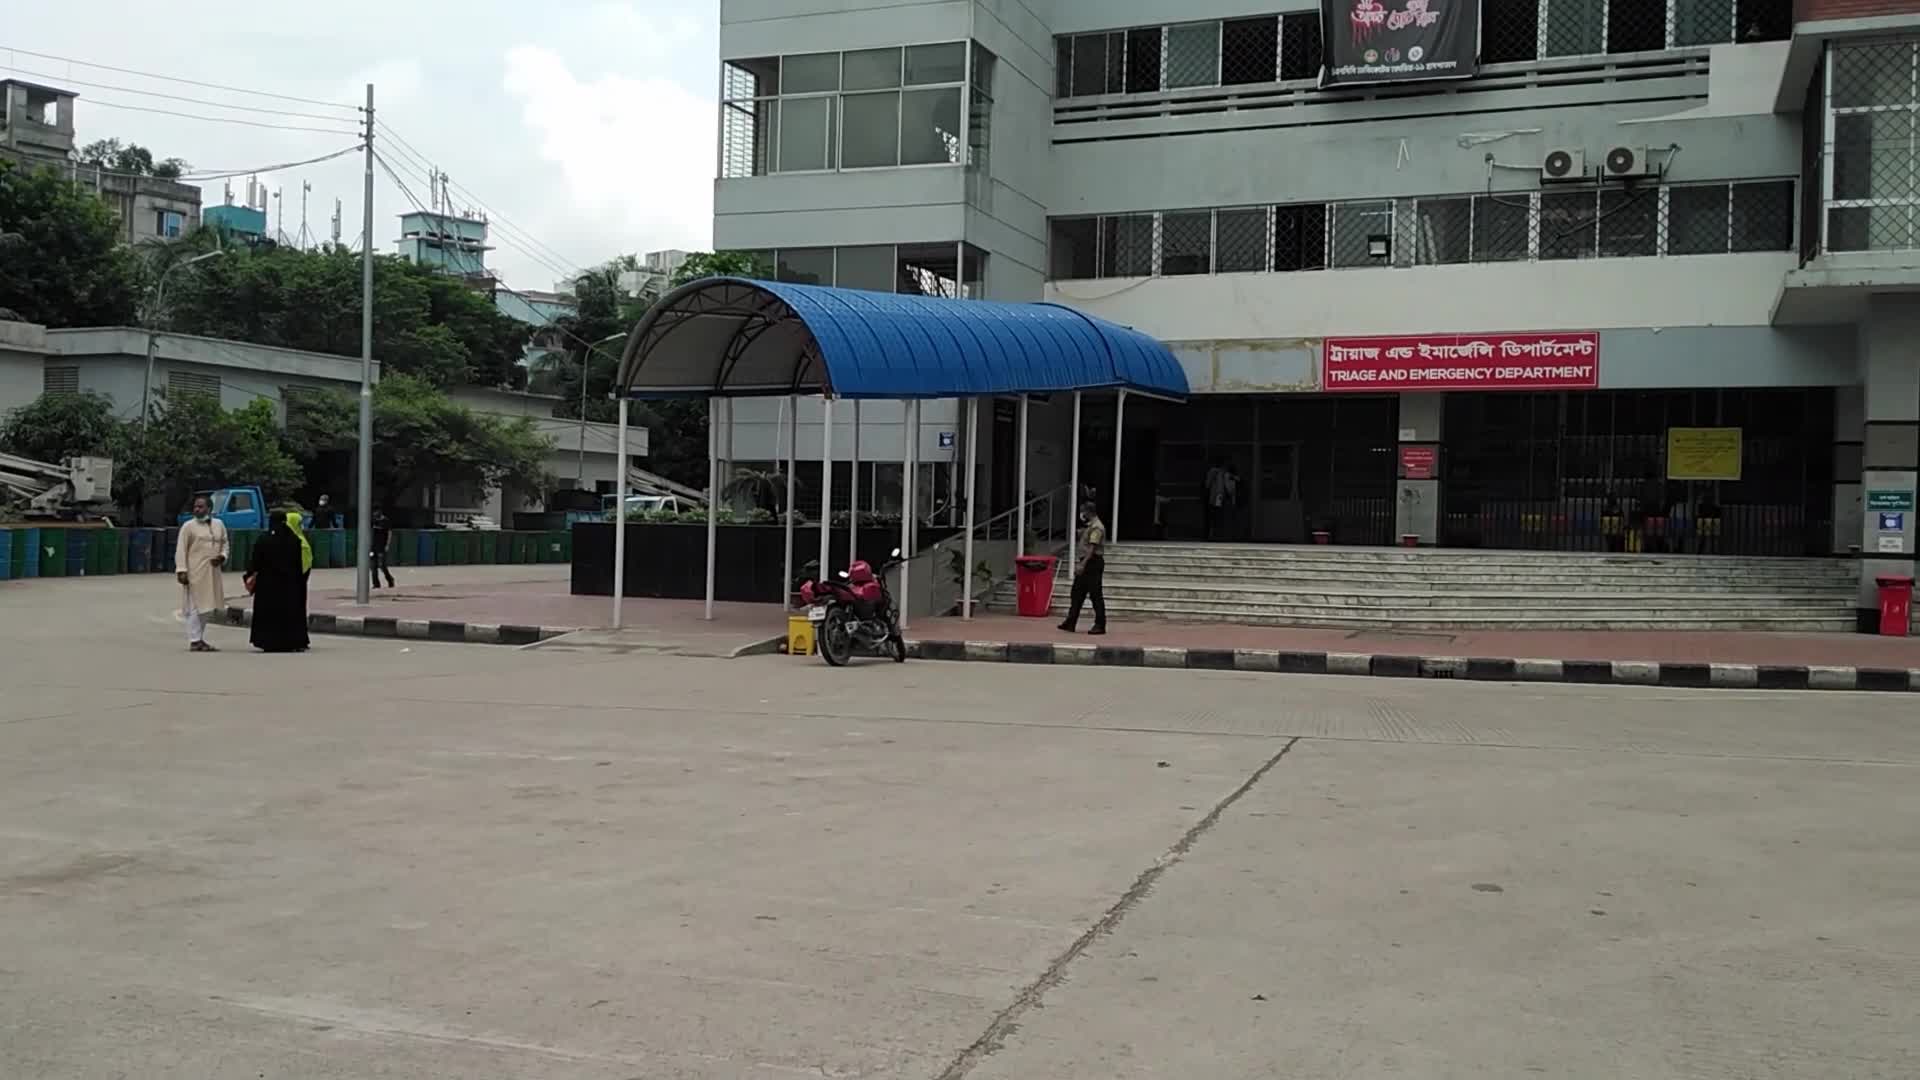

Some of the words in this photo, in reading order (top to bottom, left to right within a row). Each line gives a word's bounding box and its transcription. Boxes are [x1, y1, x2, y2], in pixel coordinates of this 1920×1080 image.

[1499, 338, 1595, 358] ডিপার্টমেন্ট
[1329, 369, 1377, 382] TRIAGE
[1378, 369, 1407, 381] AND
[1409, 367, 1494, 380] EMERGENCY
[1495, 365, 1593, 379] DEPARTMENT
